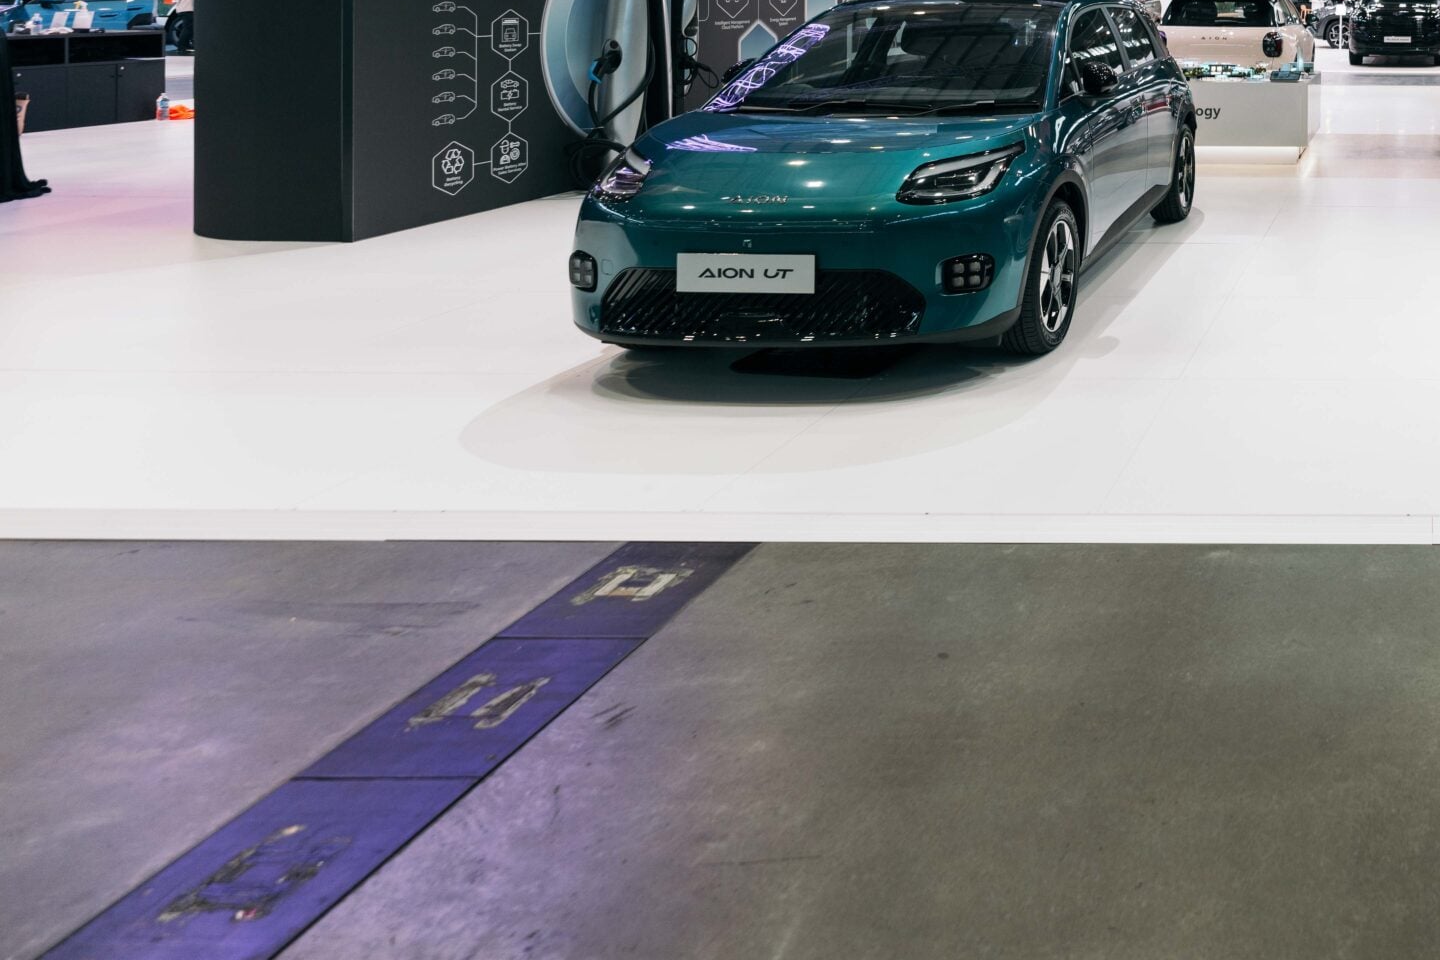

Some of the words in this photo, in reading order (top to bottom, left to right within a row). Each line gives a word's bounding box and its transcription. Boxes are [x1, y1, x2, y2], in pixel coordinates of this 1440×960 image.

[1196, 108, 1221, 119] ogy
[698, 268, 754, 279] AION
[764, 269, 794, 279] UT
